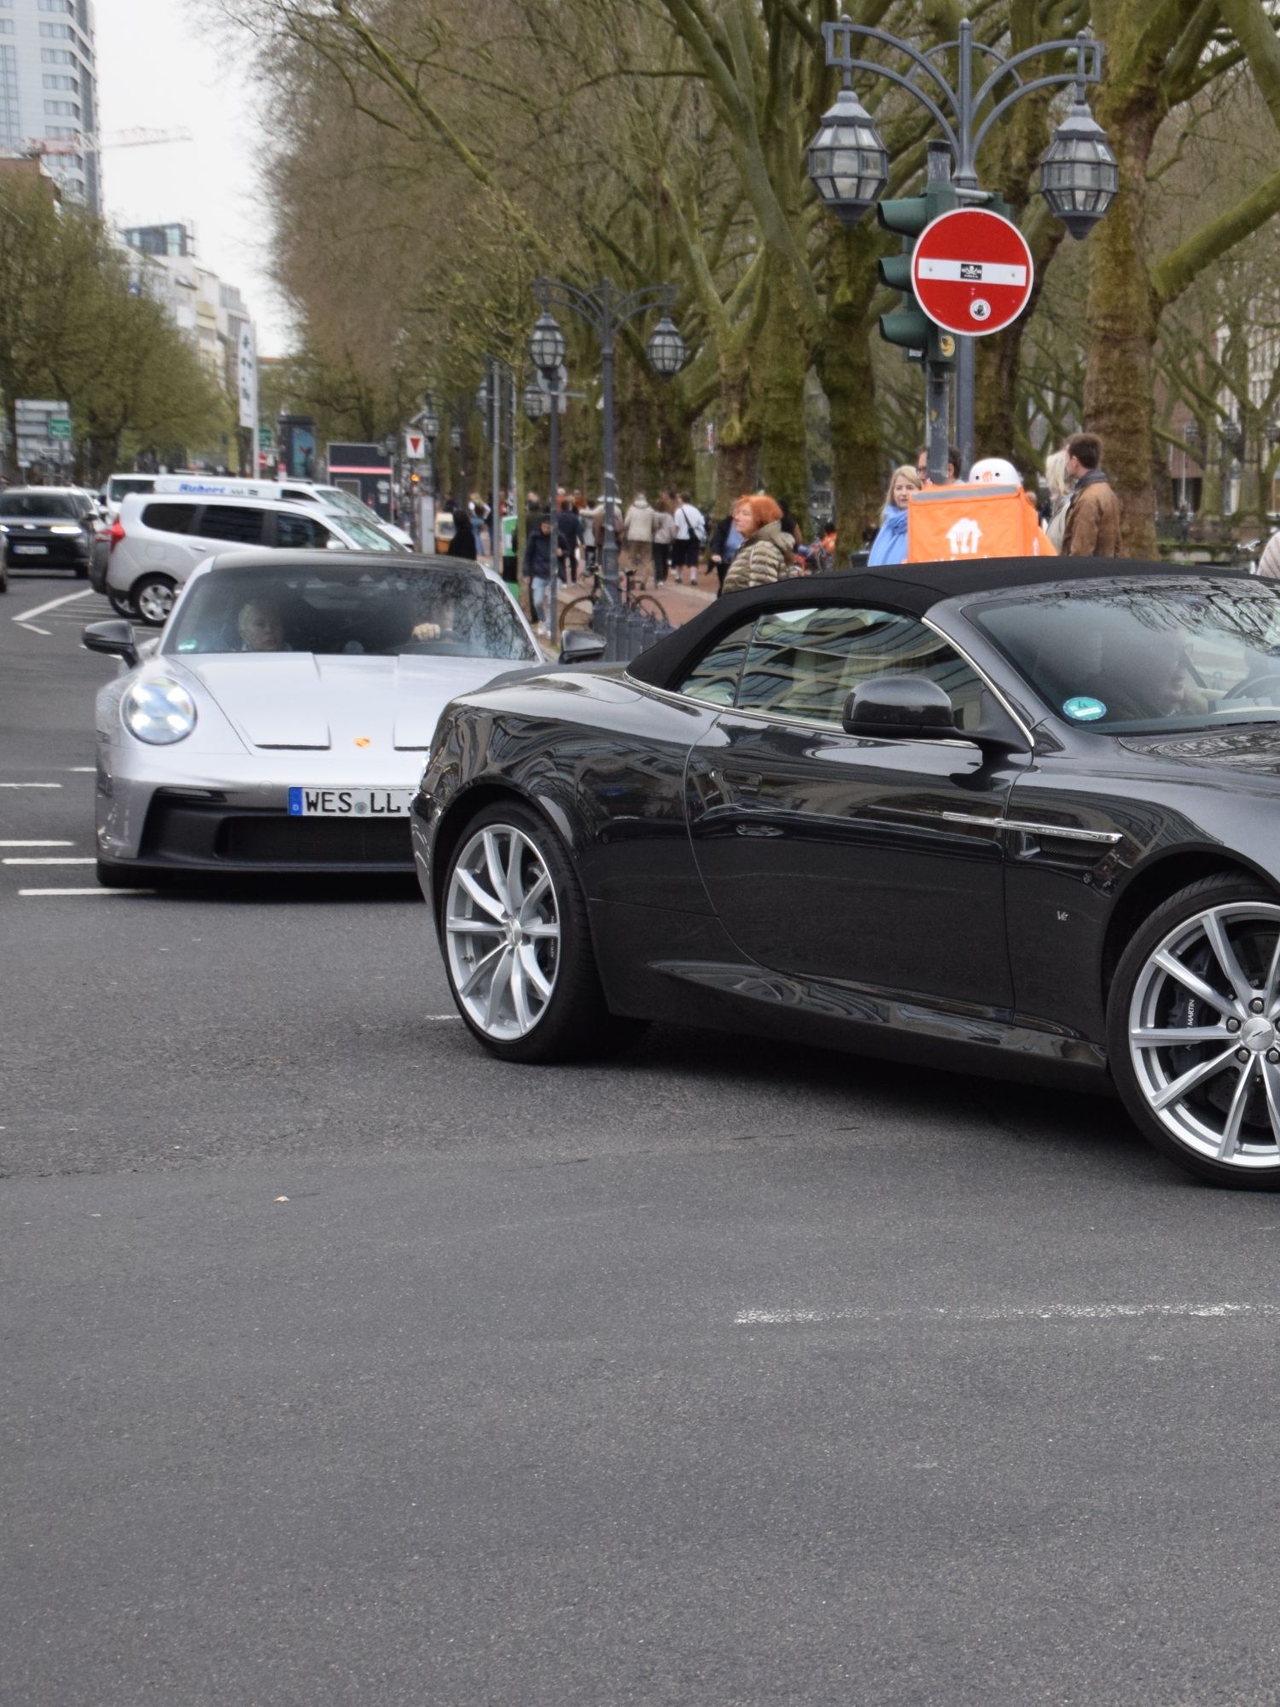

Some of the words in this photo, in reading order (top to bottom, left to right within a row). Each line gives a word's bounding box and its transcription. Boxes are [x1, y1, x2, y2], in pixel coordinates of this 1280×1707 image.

[305, 791, 353, 813] WES
[370, 792, 402, 813] LL
[1187, 999, 1195, 1027] MARTIN
